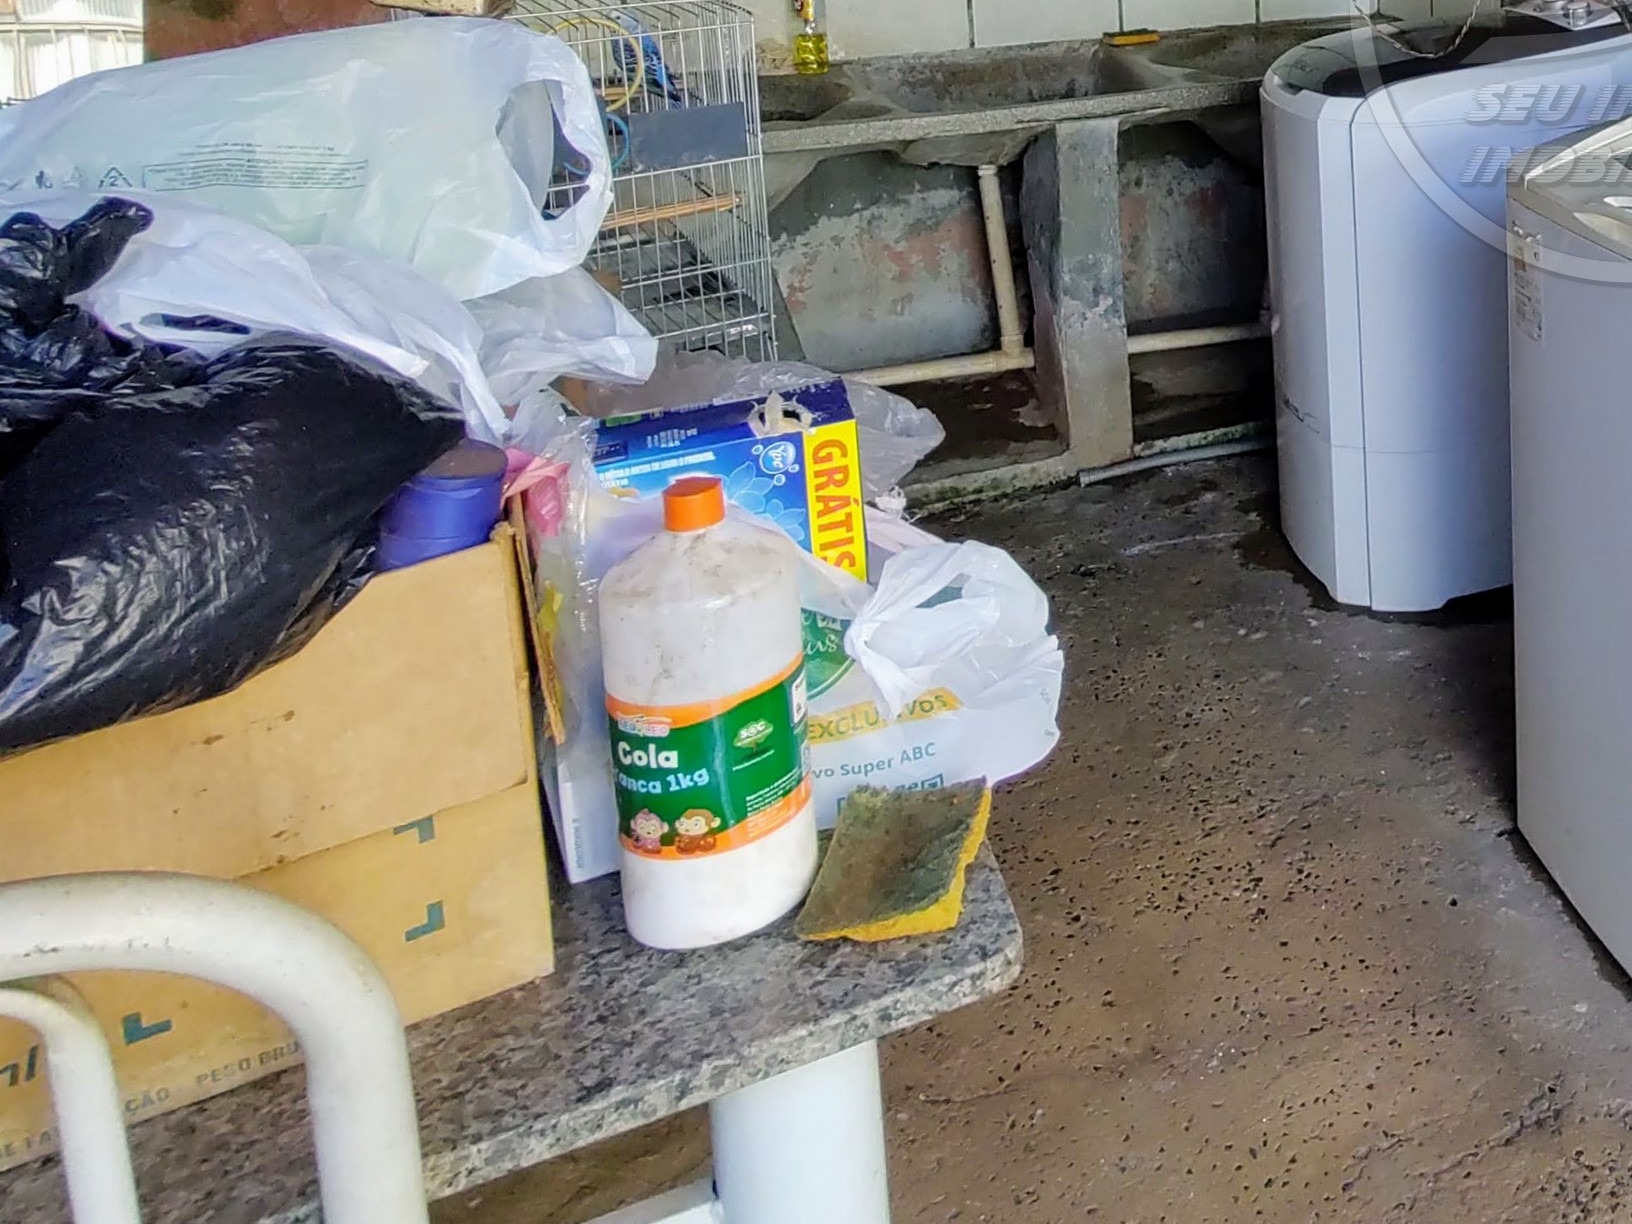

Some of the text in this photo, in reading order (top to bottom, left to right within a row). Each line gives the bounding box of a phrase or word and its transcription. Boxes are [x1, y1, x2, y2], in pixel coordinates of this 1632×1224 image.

[812, 439, 860, 568] GRÁTIS
[809, 694, 949, 740] EXCLUVOS
[618, 741, 679, 769] Cola
[812, 742, 937, 779] vo Super ABC
[613, 767, 710, 794] anca 1kg
[123, 1086, 171, 1116] ÇÃO
[195, 1056, 252, 1087] PESO
[257, 1039, 302, 1067] BRU
